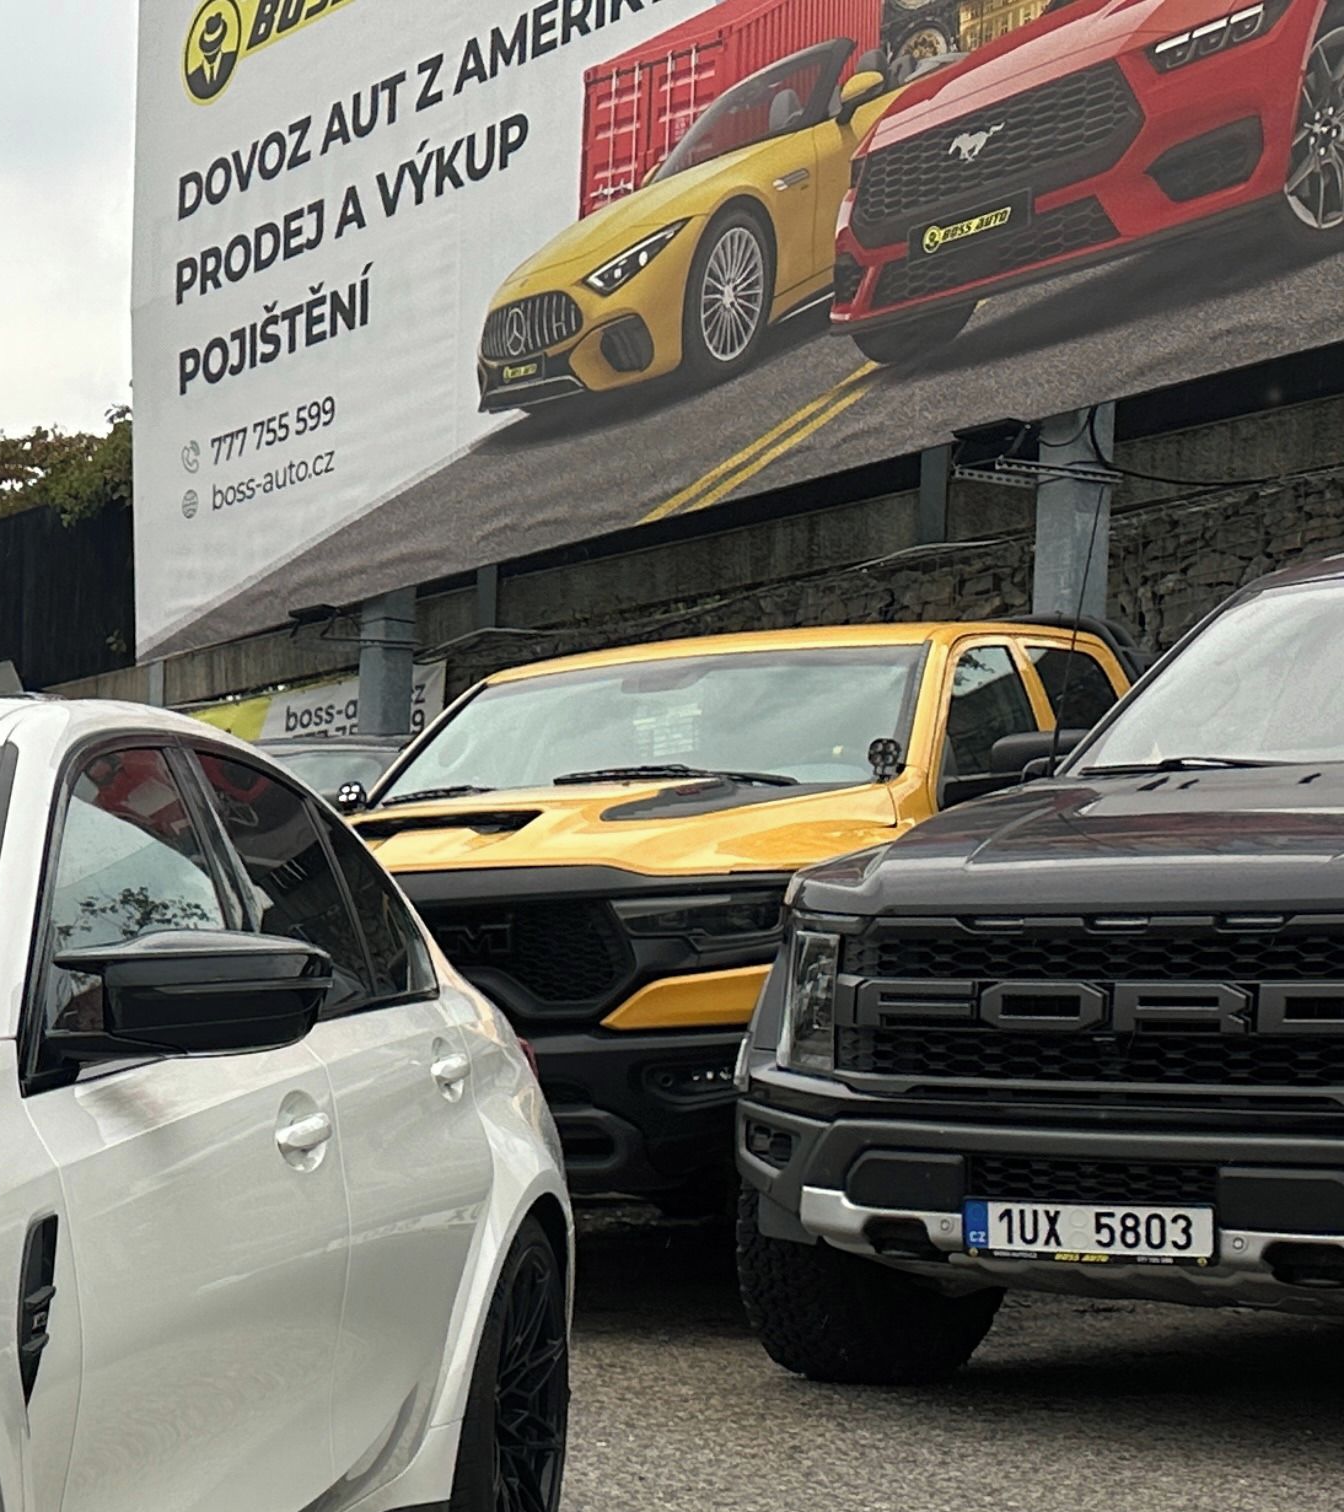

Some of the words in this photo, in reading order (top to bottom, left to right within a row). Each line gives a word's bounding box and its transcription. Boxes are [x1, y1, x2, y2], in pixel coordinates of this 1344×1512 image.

[246, 0, 352, 50] BO
[178, 116, 312, 221] DOVOZ
[320, 71, 407, 155] AUT
[415, 48, 444, 109] Z
[453, 0, 666, 95] AMERI
[175, 209, 324, 304] PRODEJ
[335, 186, 366, 239] A
[376, 113, 528, 217] VÝKUP
[975, 210, 1008, 230] AUTO
[179, 263, 374, 394] POJIŠTĚNÍ
[211, 427, 247, 465] 777
[253, 412, 289, 450] 755
[295, 396, 335, 435] 599
[212, 451, 335, 510] boss-auto.cz
[969, 1231, 986, 1243] CZ
[998, 1208, 1062, 1247] 1UX
[1095, 1211, 1193, 1250] 5803
